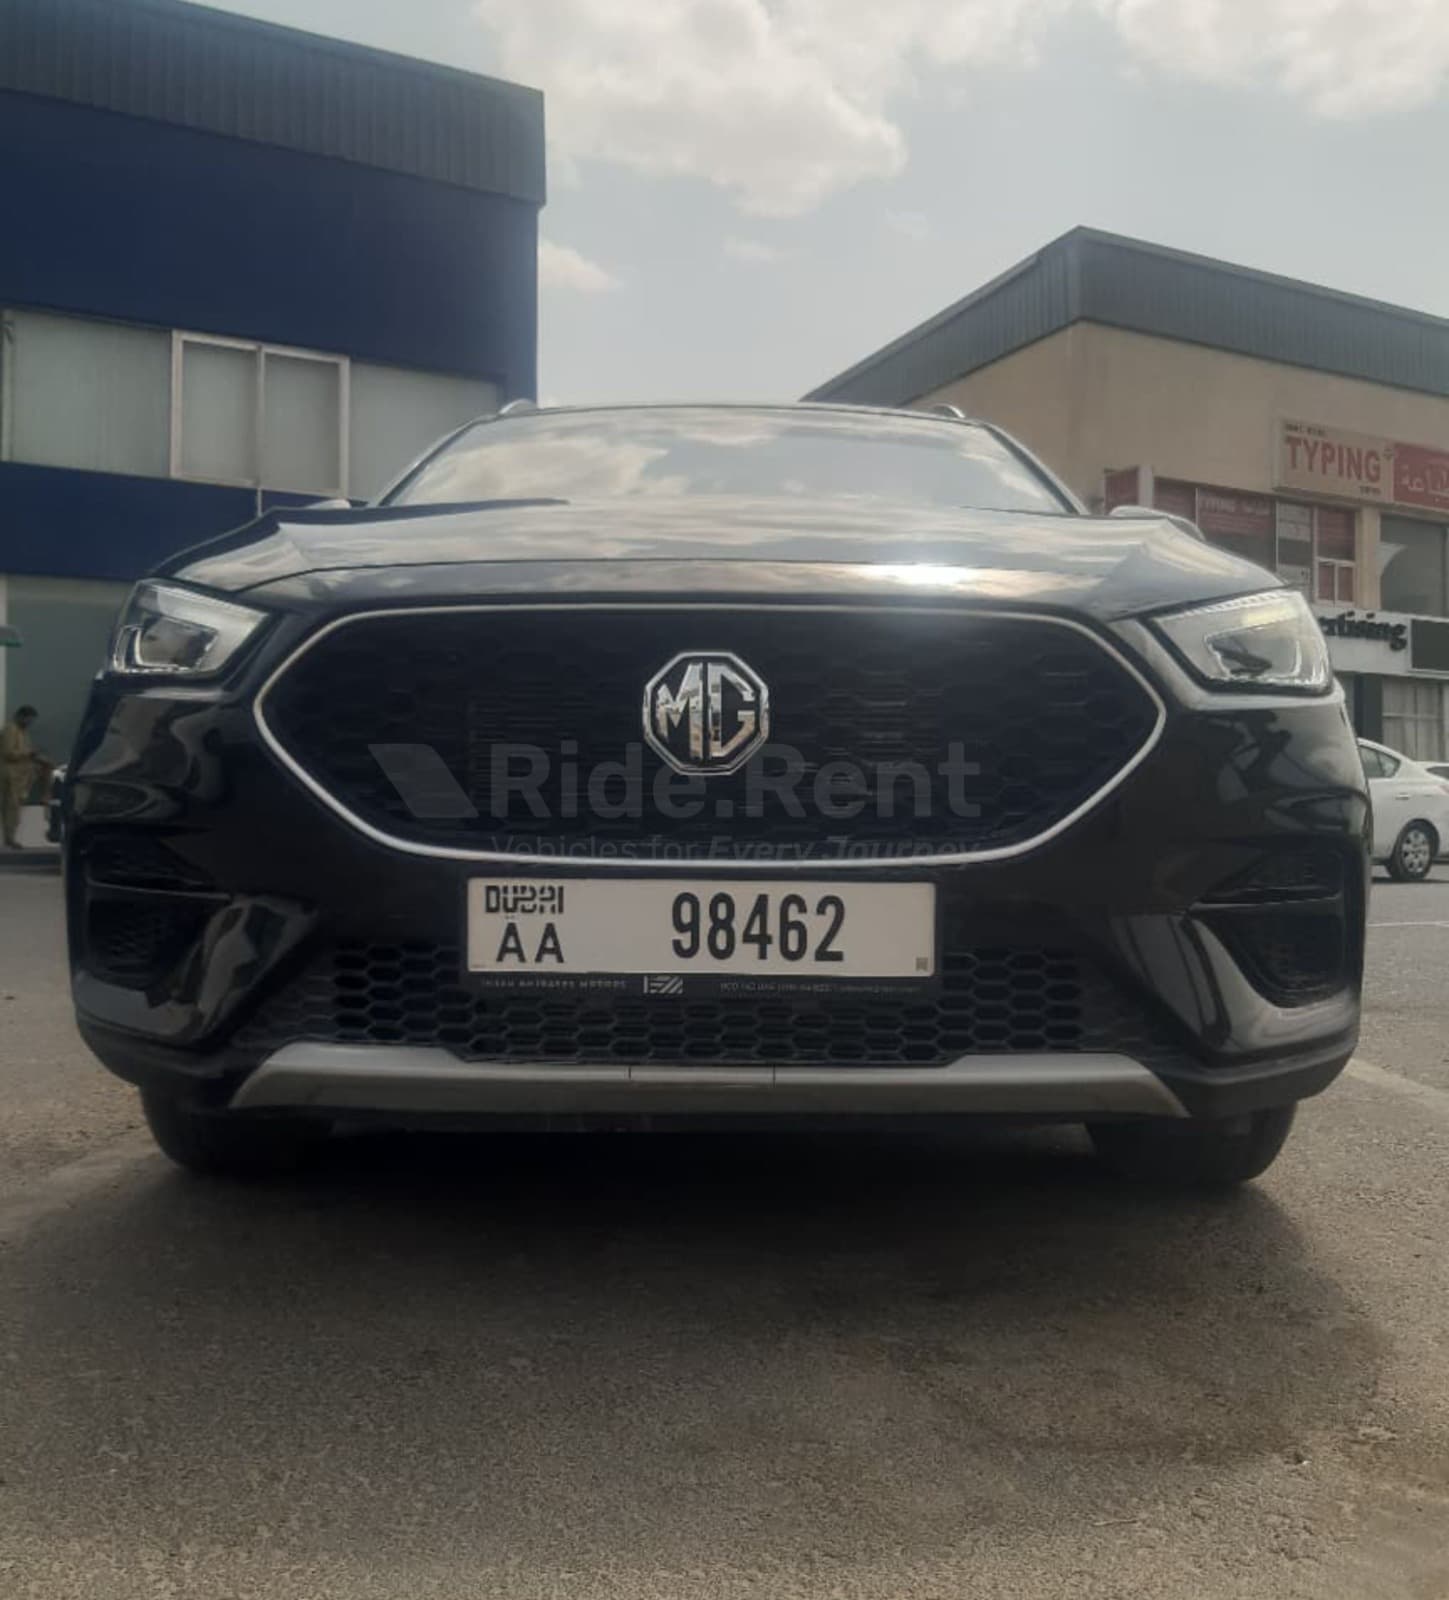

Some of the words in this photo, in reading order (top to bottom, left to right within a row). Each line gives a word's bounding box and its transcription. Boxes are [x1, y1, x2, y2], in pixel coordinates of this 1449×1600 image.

[1285, 435, 1381, 483] TYPING
[656, 662, 755, 759] MG
[496, 922, 564, 963] AA
[672, 892, 845, 961] 98462
